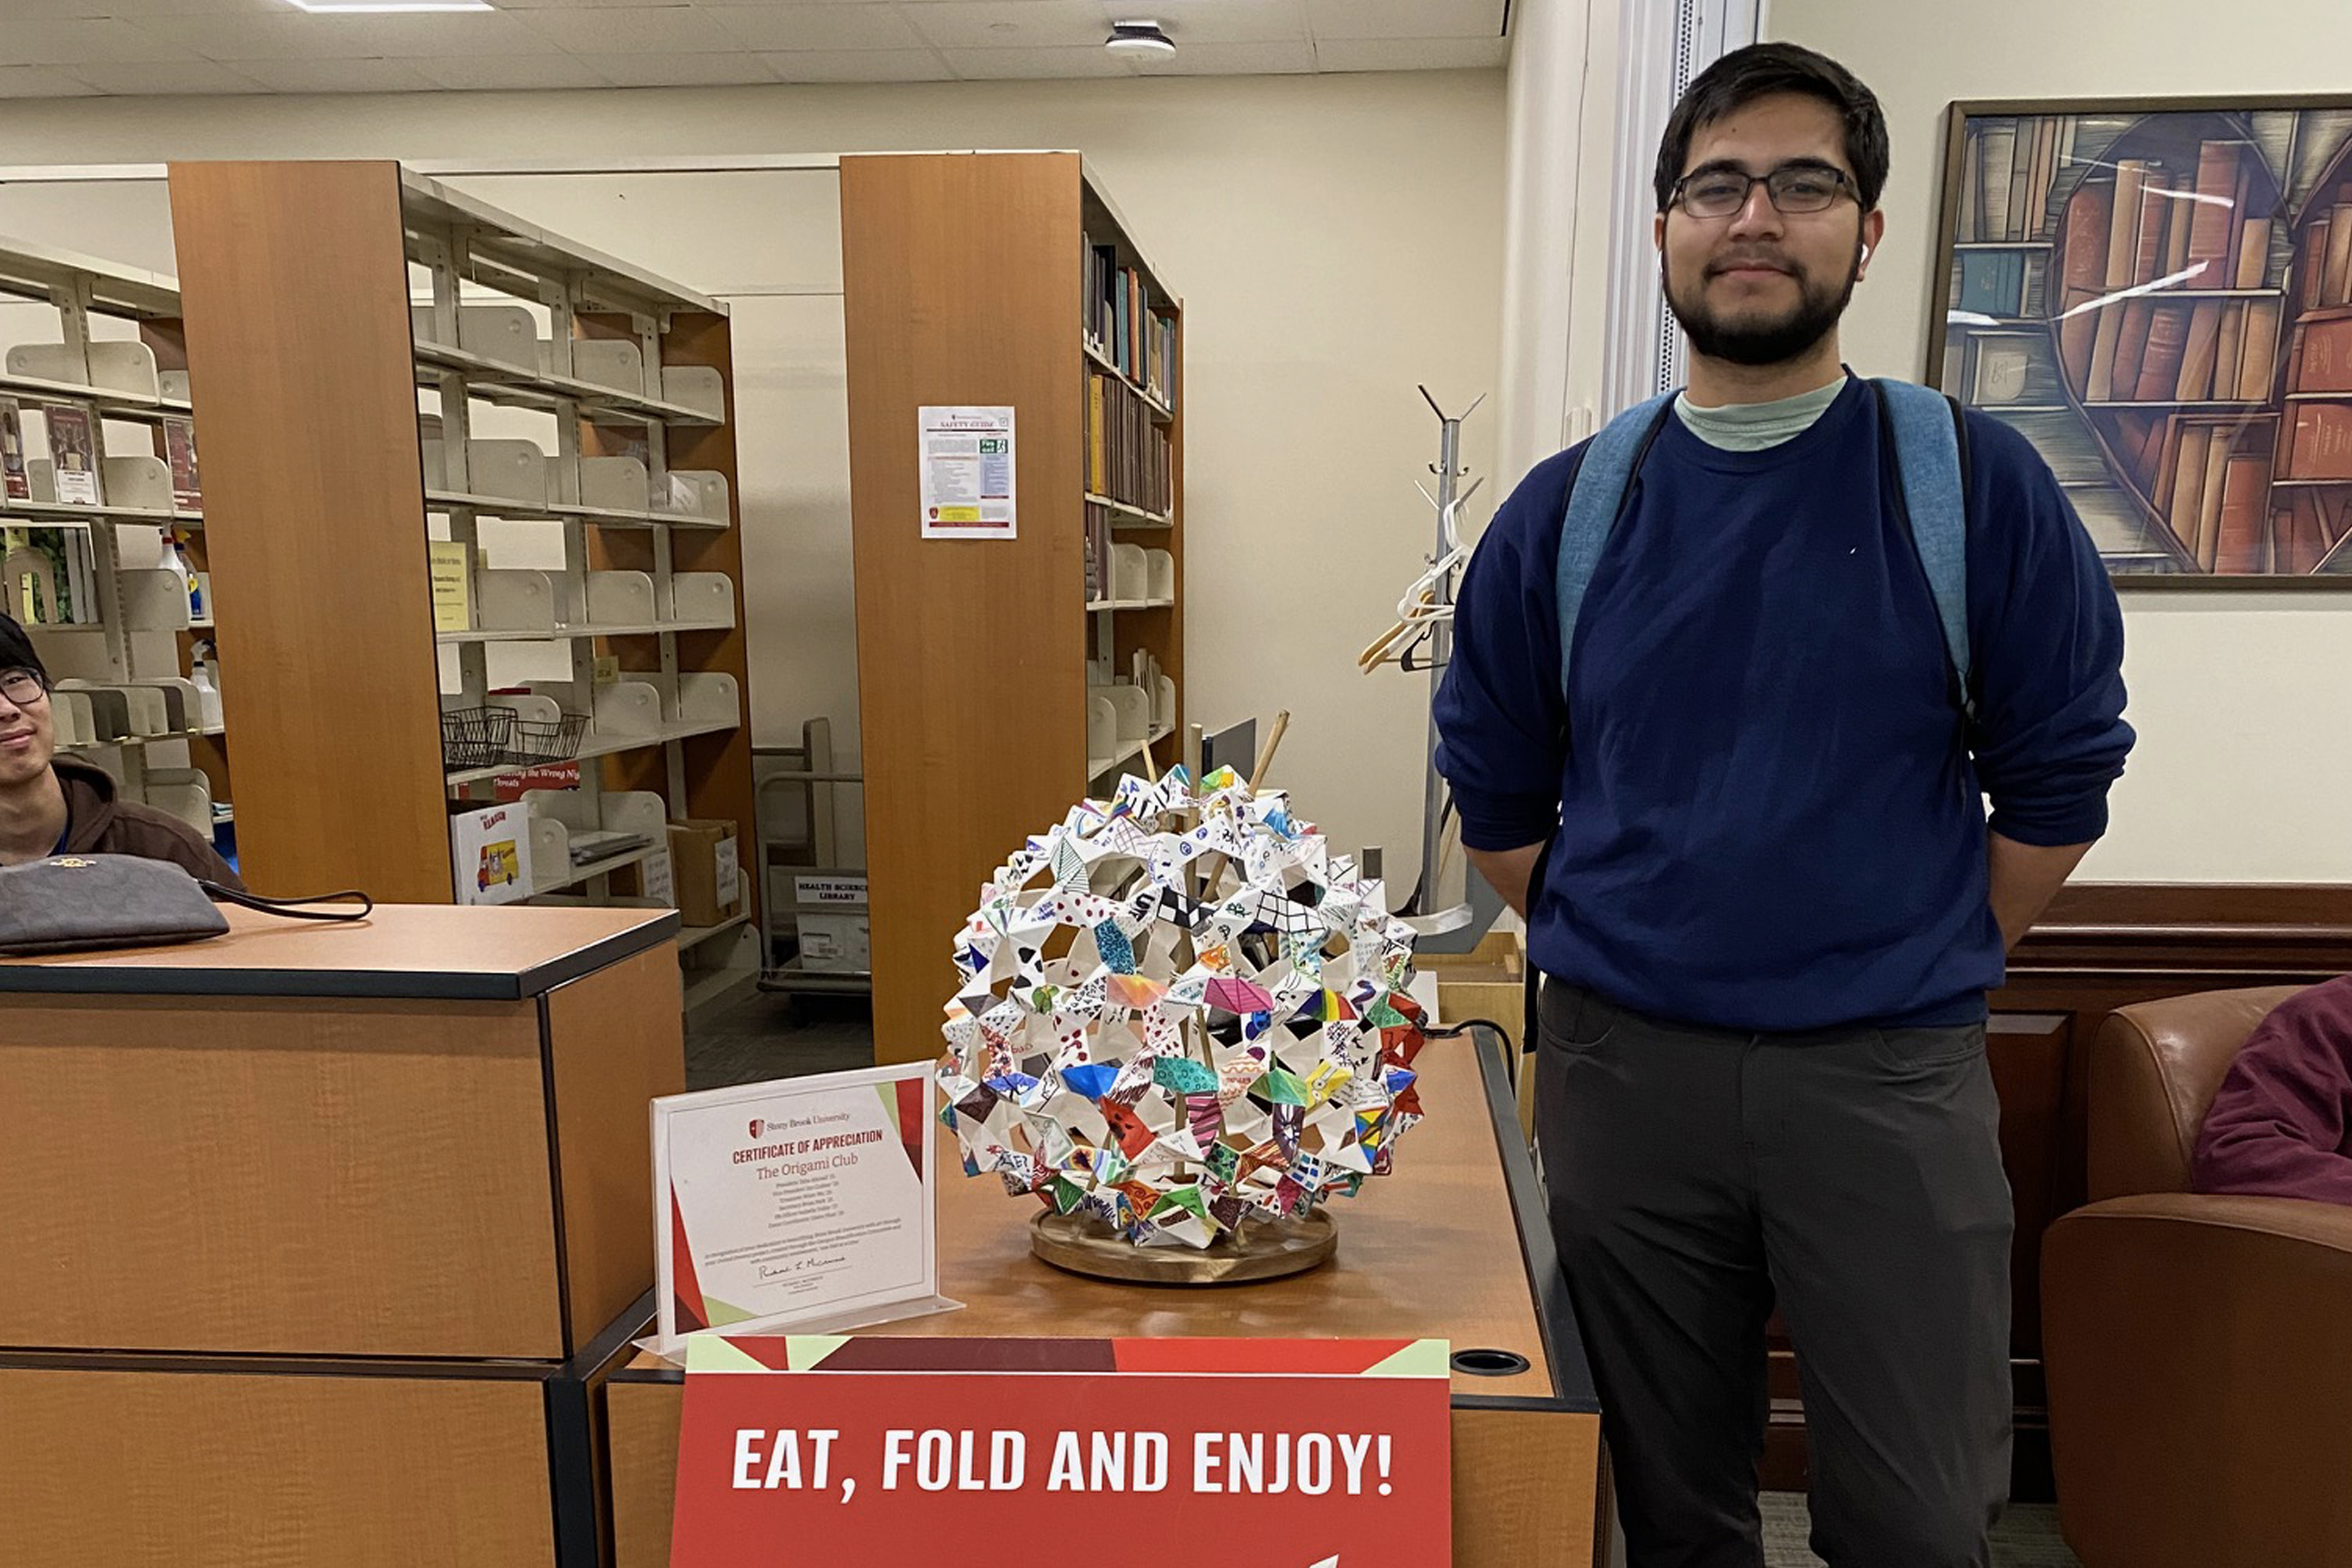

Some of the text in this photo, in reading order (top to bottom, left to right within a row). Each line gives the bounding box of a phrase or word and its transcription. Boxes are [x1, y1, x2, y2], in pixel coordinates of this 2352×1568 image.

[527, 768, 539, 777] the
[540, 769, 565, 779] Wrong
[767, 1112, 849, 1131] Stony Brook University
[733, 1129, 883, 1165] CERTIFICATE OF APPRECIATION
[757, 1153, 858, 1180] The Origami Club
[732, 1429, 1393, 1504] EAT, FOLD AND ENJOY!
